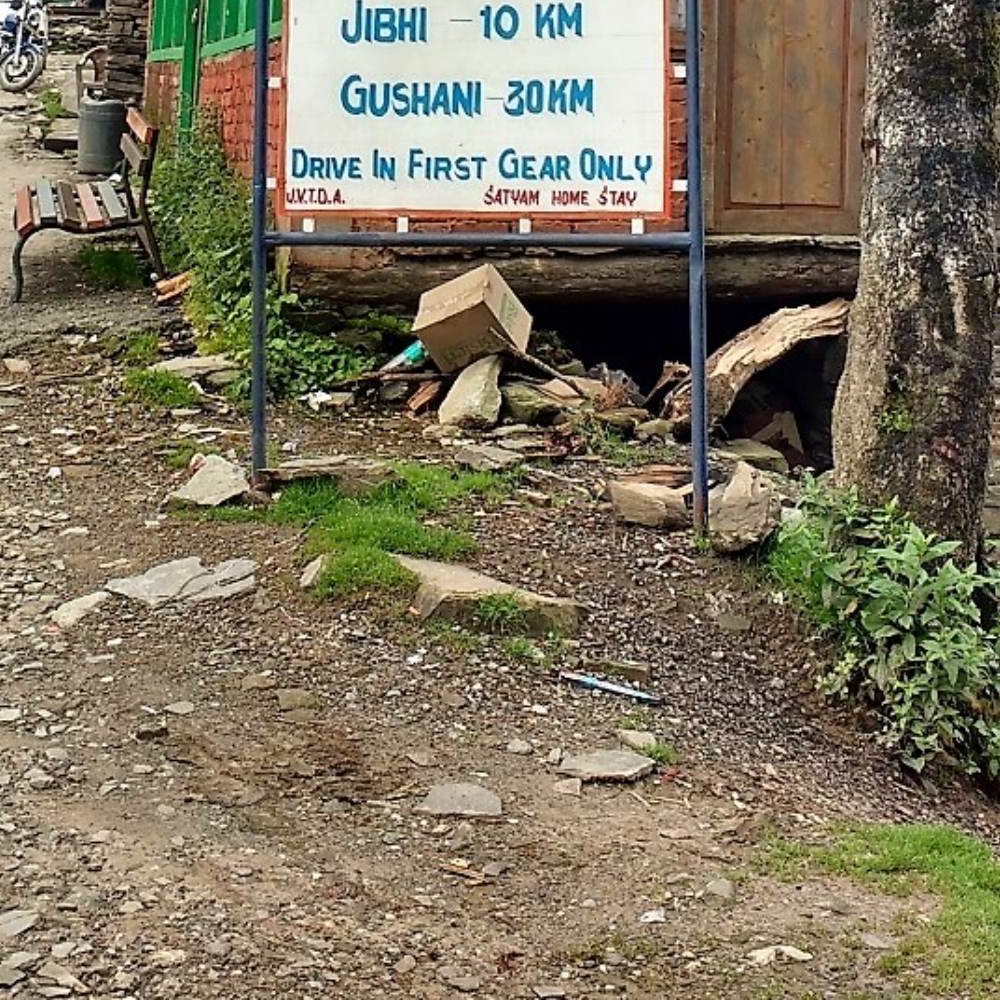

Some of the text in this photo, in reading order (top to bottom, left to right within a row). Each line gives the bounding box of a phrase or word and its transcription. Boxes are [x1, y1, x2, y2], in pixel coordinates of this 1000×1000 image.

[341, 0, 582, 44] JIBHI 10 KM
[340, 74, 481, 118] GUSHANI
[292, 148, 652, 182] DRIVE IN FIRST GEAR ONLY
[484, 185, 637, 206] SATYAM HOME STAY
